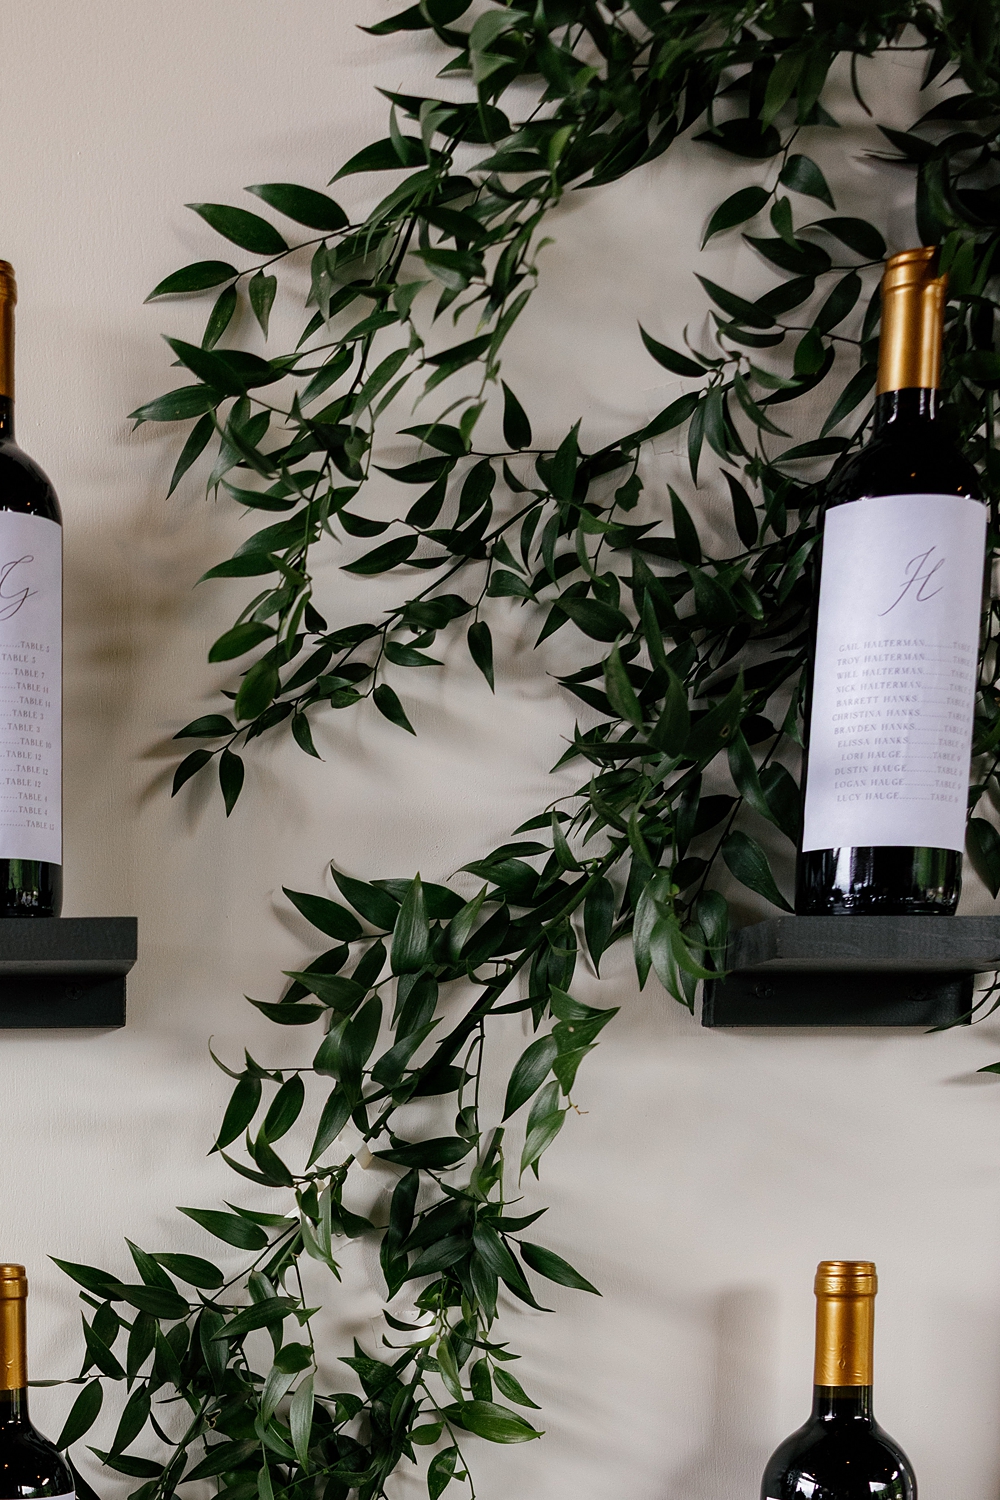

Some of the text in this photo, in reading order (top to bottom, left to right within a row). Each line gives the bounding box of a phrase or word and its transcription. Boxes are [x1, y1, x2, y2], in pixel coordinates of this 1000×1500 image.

[878, 546, 946, 617] H
[839, 639, 925, 653] GAIL HALTERMAN
[2, 653, 28, 662] TABLE
[836, 695, 917, 707] BARRETT HANKS
[12, 709, 37, 719] TABLE
[832, 709, 921, 721] CHRISTINA HANKS
[5, 749, 32, 759] TABLE
[841, 751, 956, 761] LORI HAUGE TABLE
[5, 777, 32, 787] TABLE
[34, 780, 41, 788] 12
[837, 792, 953, 802] LUCY HAUGE TABLE
